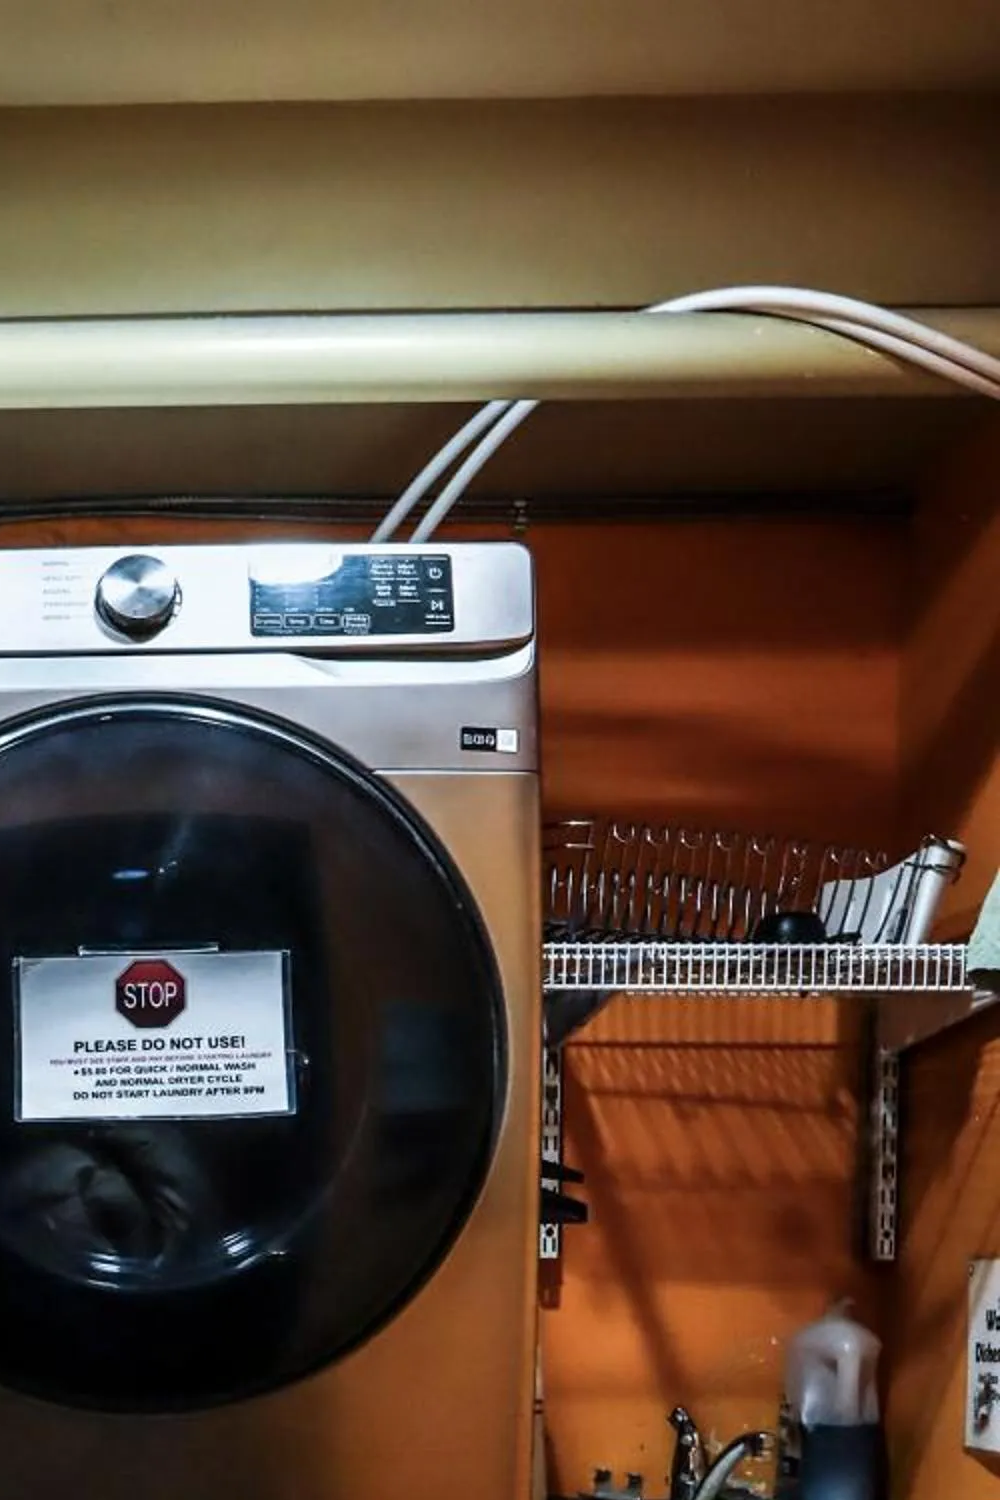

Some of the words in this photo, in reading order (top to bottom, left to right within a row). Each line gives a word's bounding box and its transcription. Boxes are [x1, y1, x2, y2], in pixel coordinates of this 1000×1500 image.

[124, 982, 177, 1008] STOP
[73, 1039, 137, 1053] PLEASE
[141, 1038, 165, 1051] DO
[169, 1037, 203, 1050] NOT
[207, 1035, 245, 1049] USE!
[109, 1065, 132, 1075] FOR
[133, 1065, 166, 1075] QUICK
[175, 1063, 221, 1073] NORMAL
[223, 1061, 257, 1071] WASH
[95, 1078, 117, 1087] AND
[119, 1077, 165, 1087] NORMAL
[167, 1075, 205, 1086] DRYER
[206, 1074, 243, 1084] CYCLE
[73, 1092, 89, 1101] DO
[92, 1090, 113, 1099] NOT
[115, 1089, 150, 1099] START
[152, 1087, 202, 1098] LAUNDRY
[205, 1086, 241, 1096] AFTER
